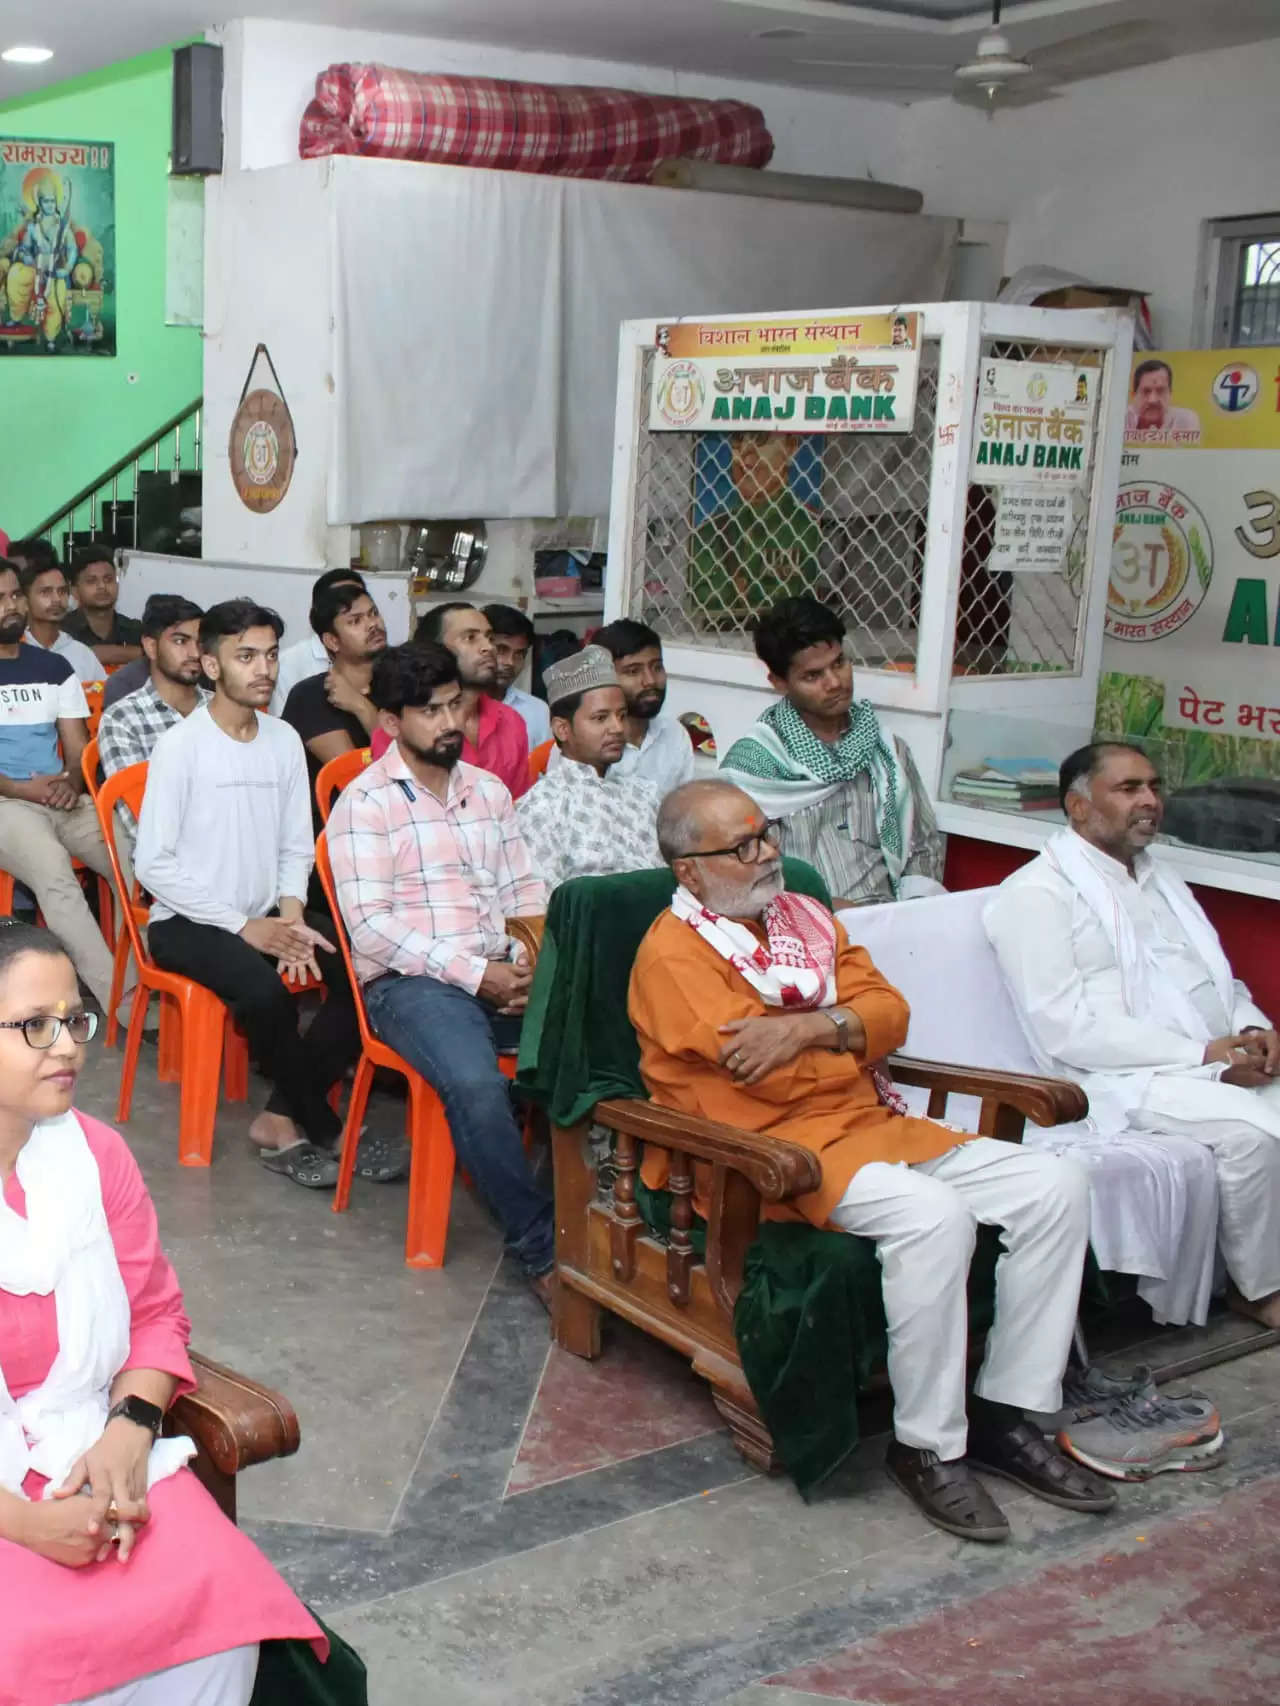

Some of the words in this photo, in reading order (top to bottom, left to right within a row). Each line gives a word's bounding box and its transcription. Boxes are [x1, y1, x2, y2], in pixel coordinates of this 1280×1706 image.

[1, 142, 88, 166] रामराज्य
[698, 326, 751, 345] विशाल
[758, 326, 799, 343] भारत
[803, 321, 863, 341] संस्थान
[713, 367, 820, 394] अनाज
[822, 355, 899, 394] बैंक
[711, 396, 796, 421] ANAJ
[804, 395, 897, 422] BANK
[980, 412, 1041, 441] अनाज
[1041, 407, 1085, 444] बैंक
[976, 441, 1029, 466] ANAJ
[1032, 444, 1083, 470] BANK
[1114, 621, 1147, 638] भारत
[1178, 686, 1225, 725] पेट
